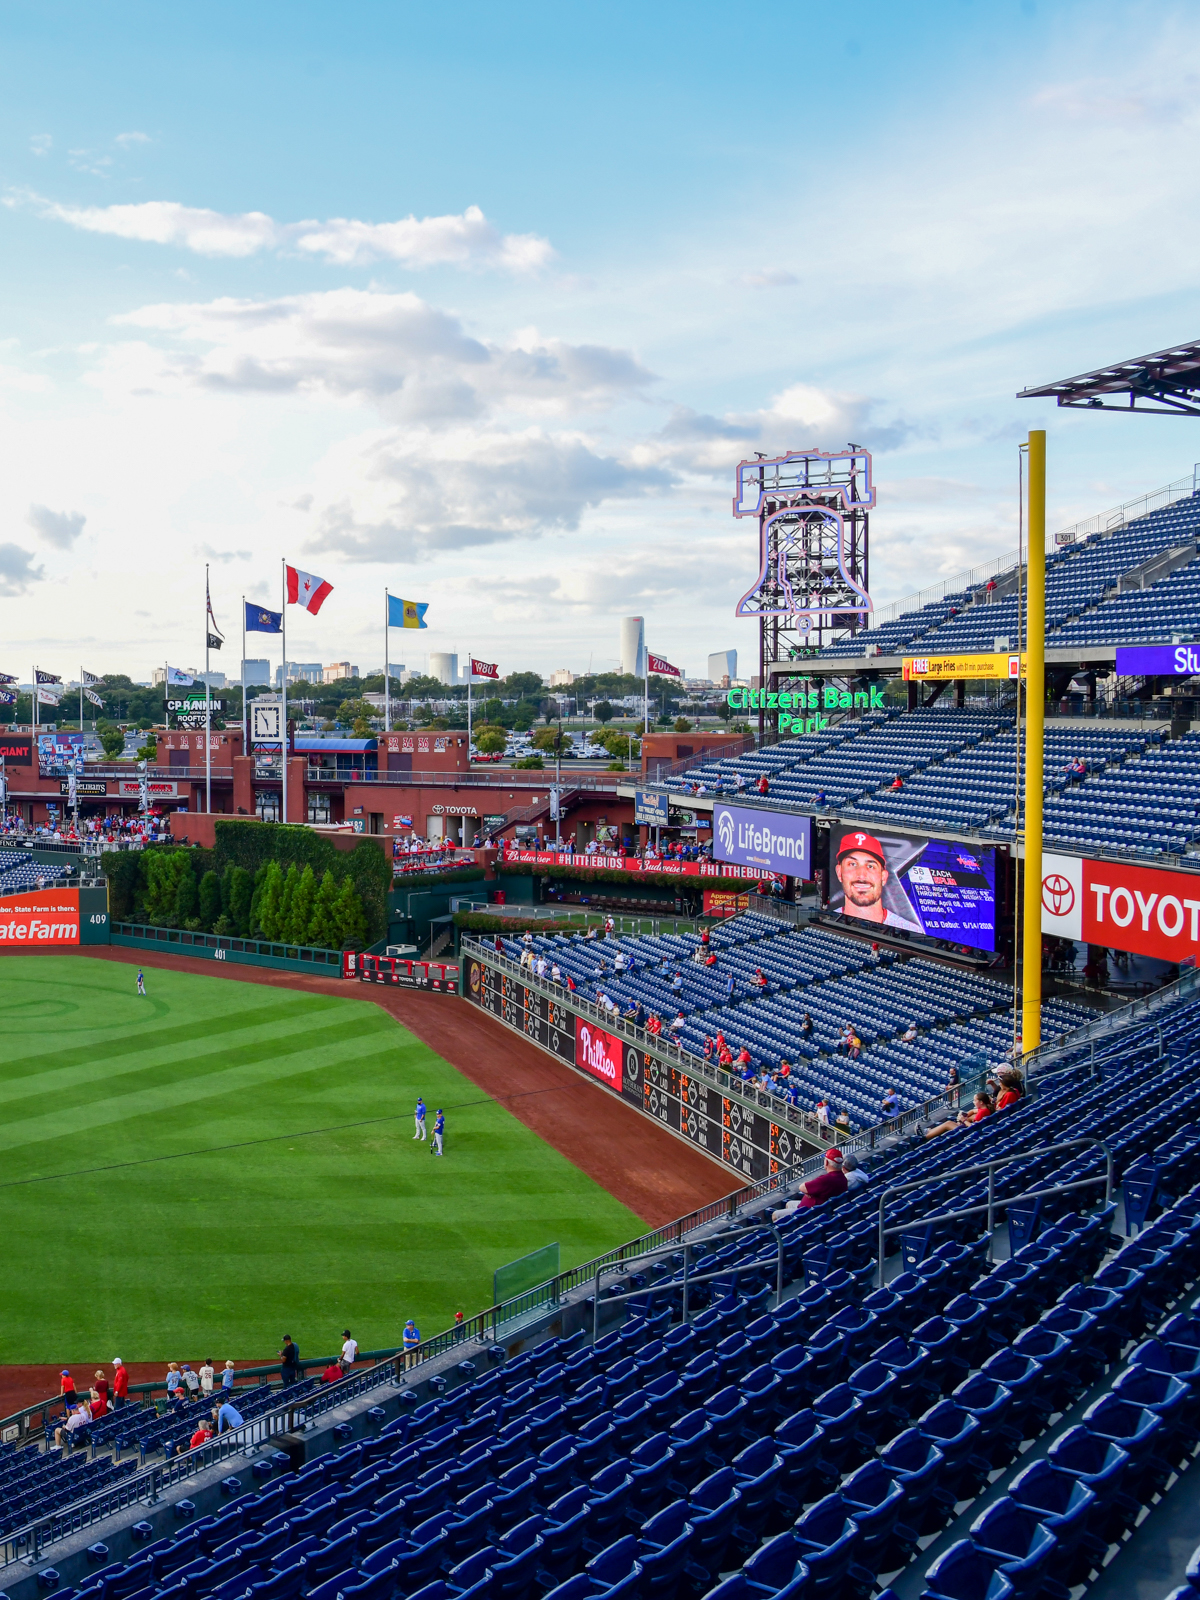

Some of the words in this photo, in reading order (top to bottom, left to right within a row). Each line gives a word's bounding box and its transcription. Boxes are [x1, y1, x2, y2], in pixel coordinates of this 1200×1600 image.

[474, 661, 494, 675] 1980
[912, 659, 929, 674] FREE
[929, 661, 943, 674] Large
[943, 660, 956, 672] Fries
[727, 687, 819, 708] Citizens
[823, 685, 885, 708] Bank
[167, 700, 181, 710] CP
[778, 712, 829, 734] Park
[388, 737, 399, 748] 32
[402, 737, 413, 748] 34
[418, 738, 429, 748] 36
[0, 746, 29, 756] GIANT
[445, 806, 477, 814] TOYOTA
[738, 823, 805, 860] LifeBrand
[506, 850, 551, 863] Budweiser
[558, 852, 623, 869] #HITTHEBUDS
[636, 859, 686, 873] Budweiser
[700, 864, 776, 881] #HITTHEBUDS
[931, 869, 952, 878] ZACH
[90, 914, 107, 924] 409
[925, 920, 940, 928] MLB
[214, 949, 226, 960] 401
[580, 1026, 616, 1079] Phillies
[659, 1076, 669, 1090] LAD
[659, 1107, 668, 1121] LAD
[741, 1108, 755, 1125] WSH
[698, 1116, 708, 1132] CHC
[742, 1125, 753, 1140] ATL
[741, 1142, 754, 1159] NYM
[794, 1136, 803, 1151] SF
